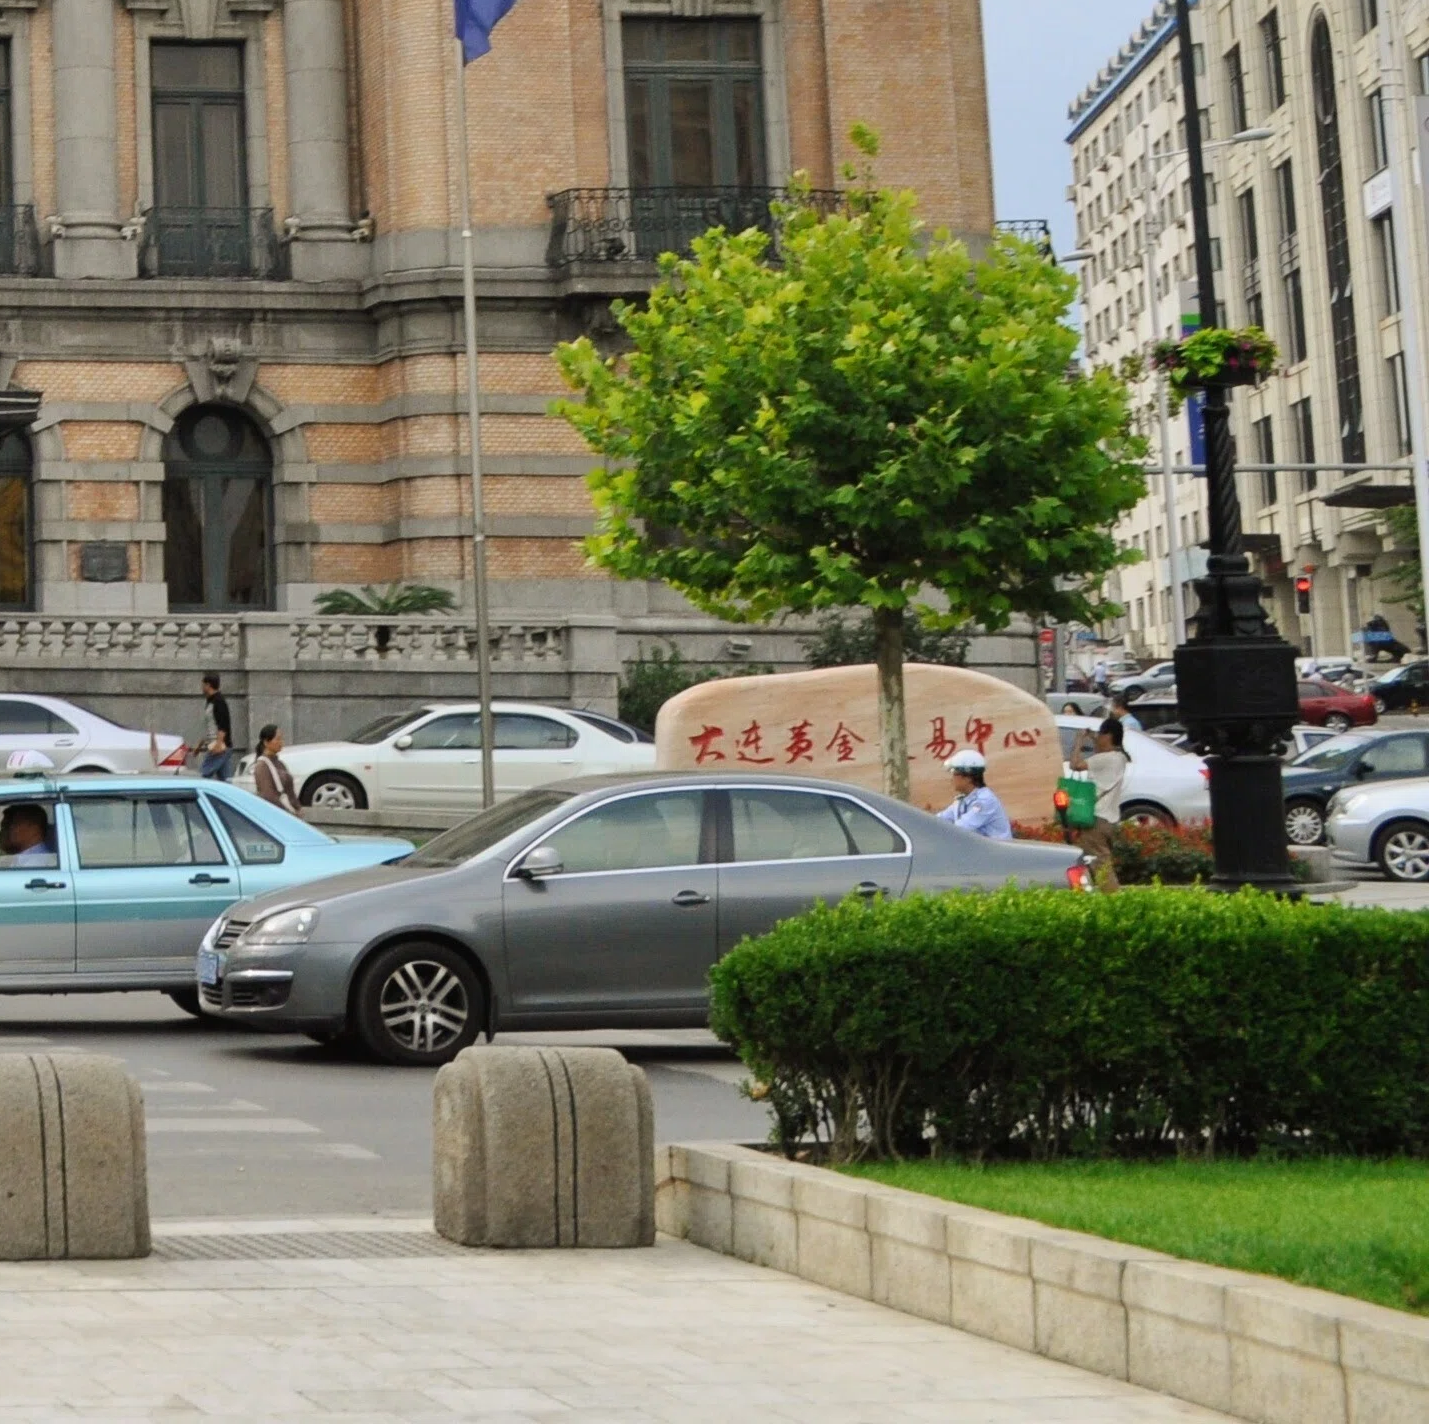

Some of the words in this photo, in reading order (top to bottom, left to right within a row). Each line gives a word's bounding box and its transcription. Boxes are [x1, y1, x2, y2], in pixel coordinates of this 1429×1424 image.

[688, 715, 1041, 765] 大连黄金易中心
